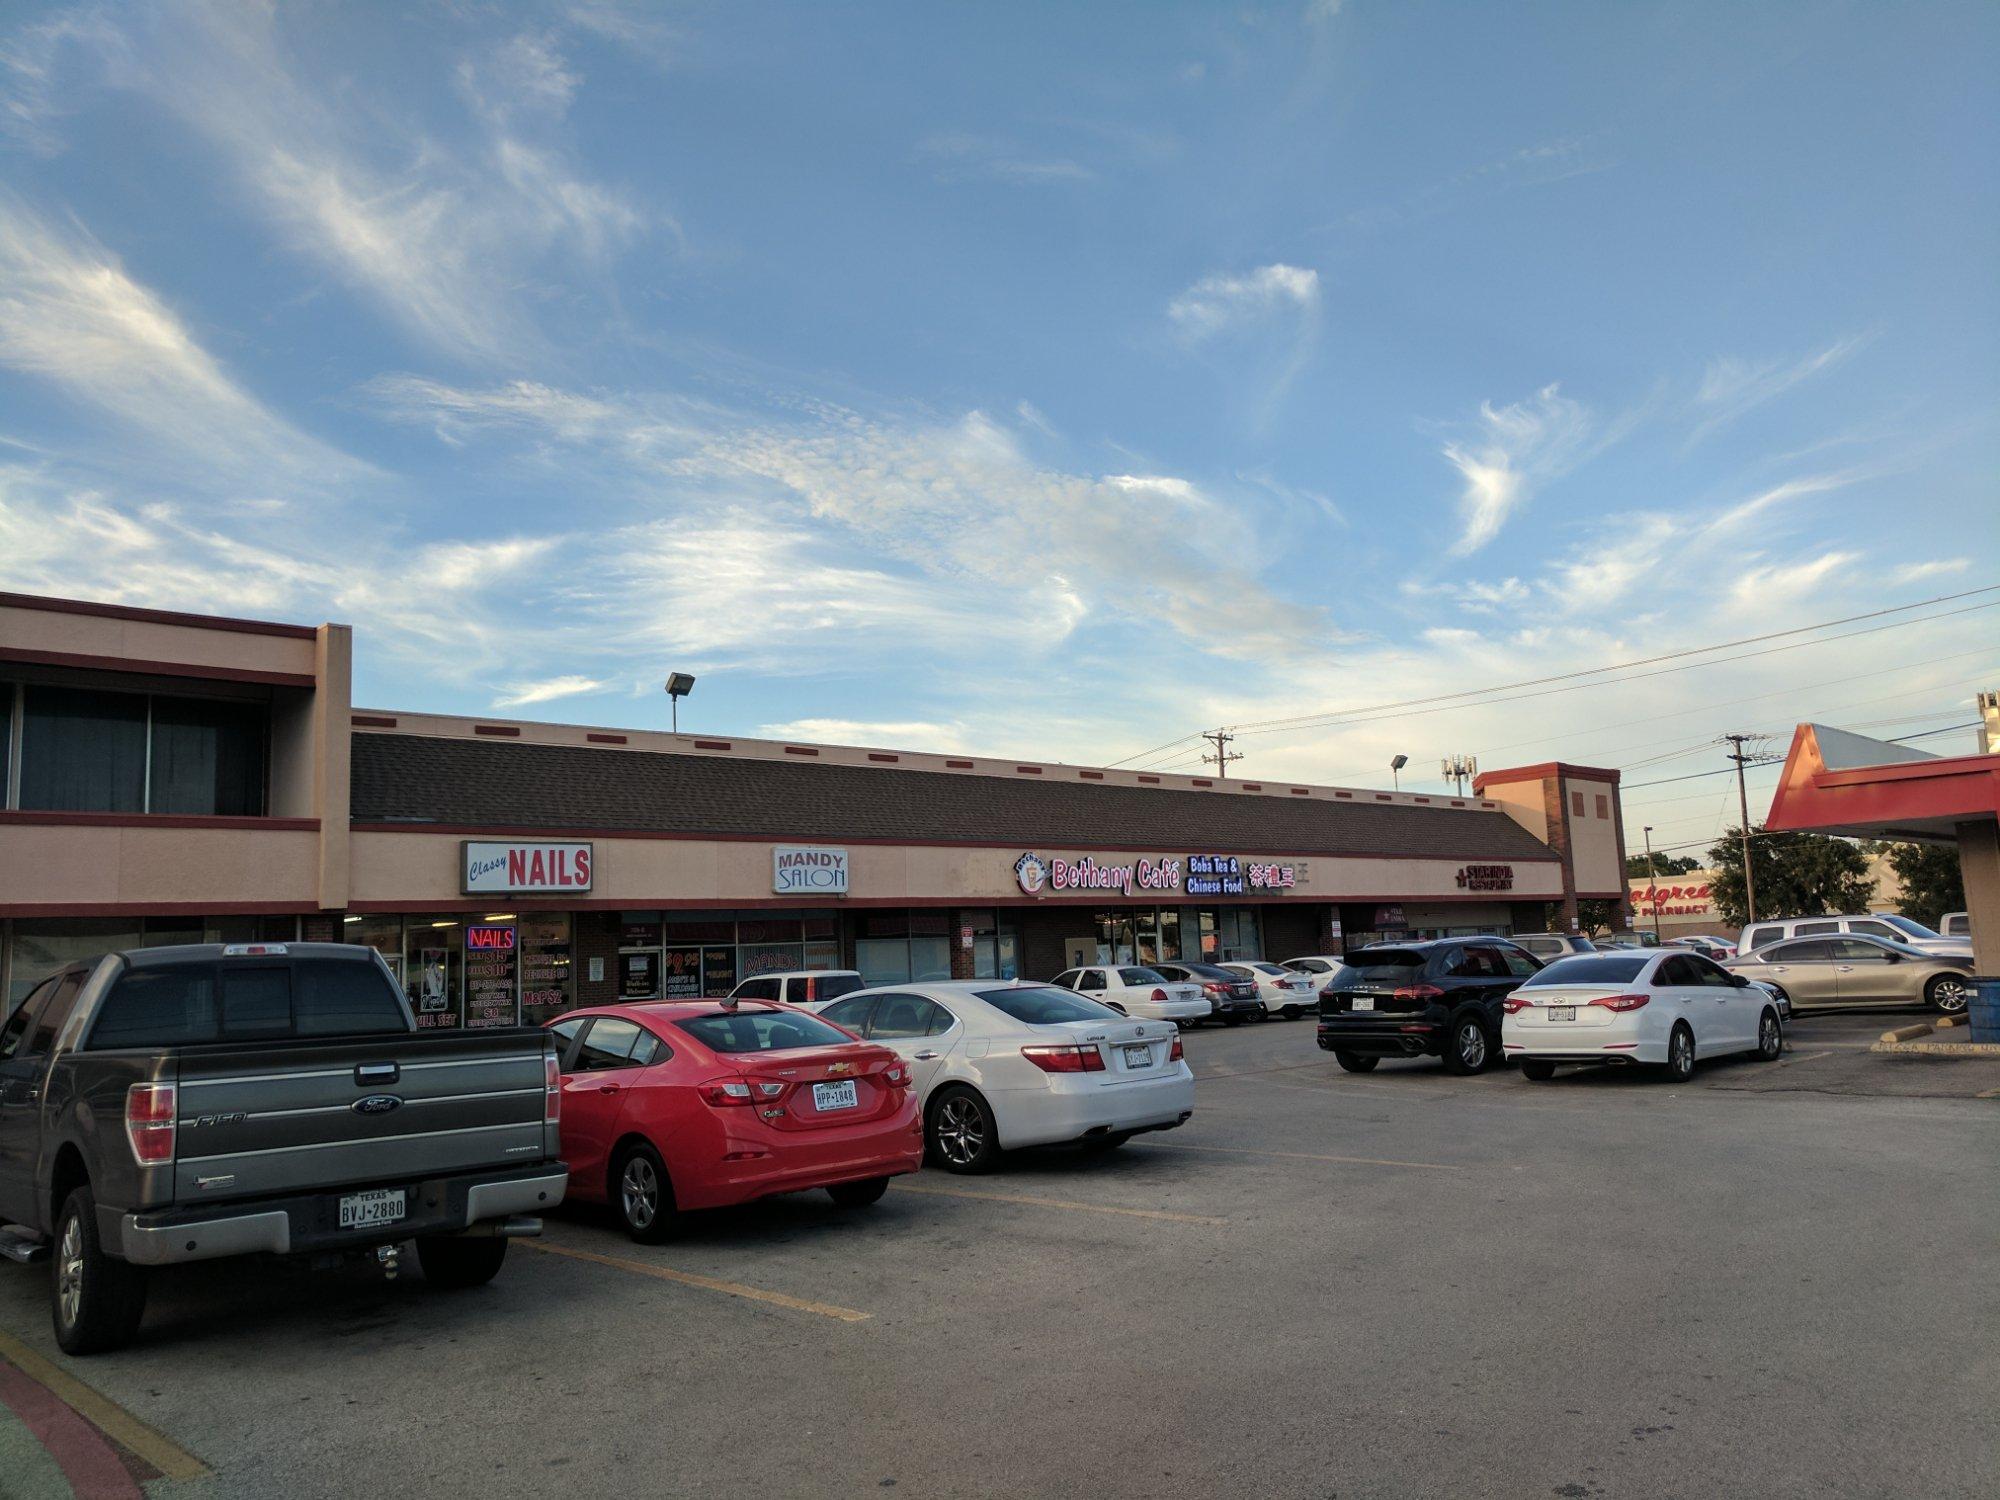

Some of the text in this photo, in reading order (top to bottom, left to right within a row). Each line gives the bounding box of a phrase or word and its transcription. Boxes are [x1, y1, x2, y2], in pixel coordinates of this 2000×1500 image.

[469, 849, 590, 885] Classy NAILS
[778, 852, 843, 868] MANDY
[1190, 857, 1237, 873] Boba Tea &
[778, 869, 845, 889] SALON
[1052, 857, 1179, 896] Bethany Café
[1466, 865, 1491, 878] STAR
[1187, 878, 1243, 893] Chinese Food
[1641, 905, 1708, 916] PHARMACY
[470, 928, 513, 948] NAILS
[437, 1013, 456, 1026] SET
[364, 1098, 392, 1111] Ford
[360, 1192, 387, 1202] TEXAS
